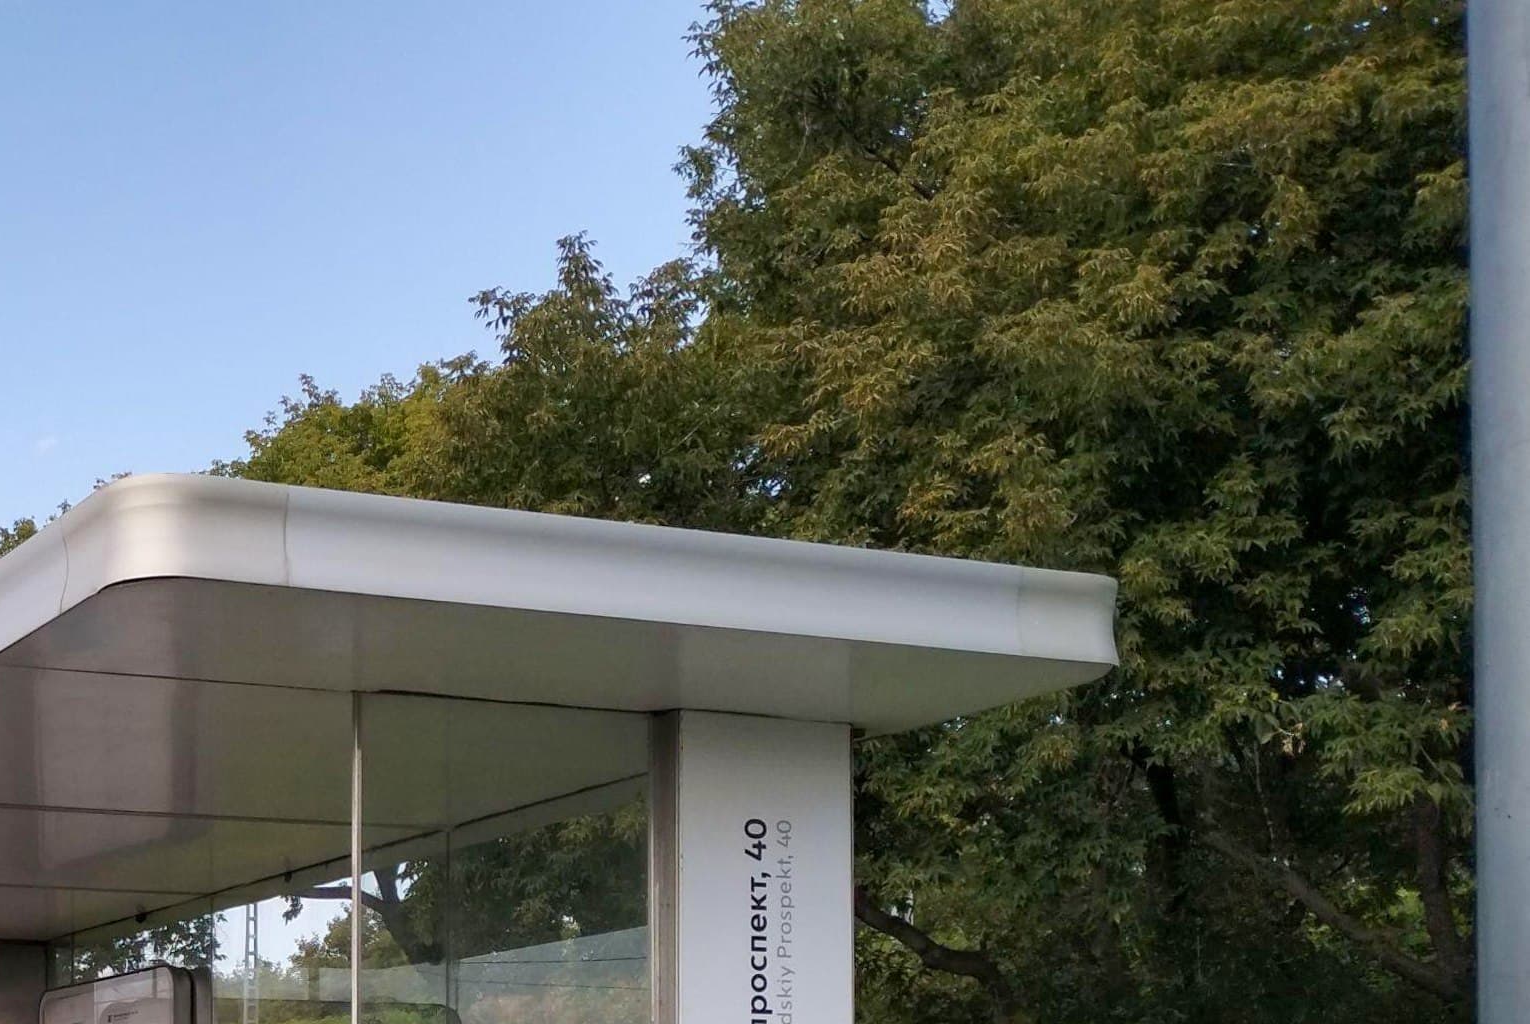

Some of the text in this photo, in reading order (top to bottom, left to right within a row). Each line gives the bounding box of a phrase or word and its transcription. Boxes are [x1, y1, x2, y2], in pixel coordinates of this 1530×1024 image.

[743, 818, 768, 862] 40
[776, 819, 792, 848] 40
[776, 855, 795, 958] Prospekt,
